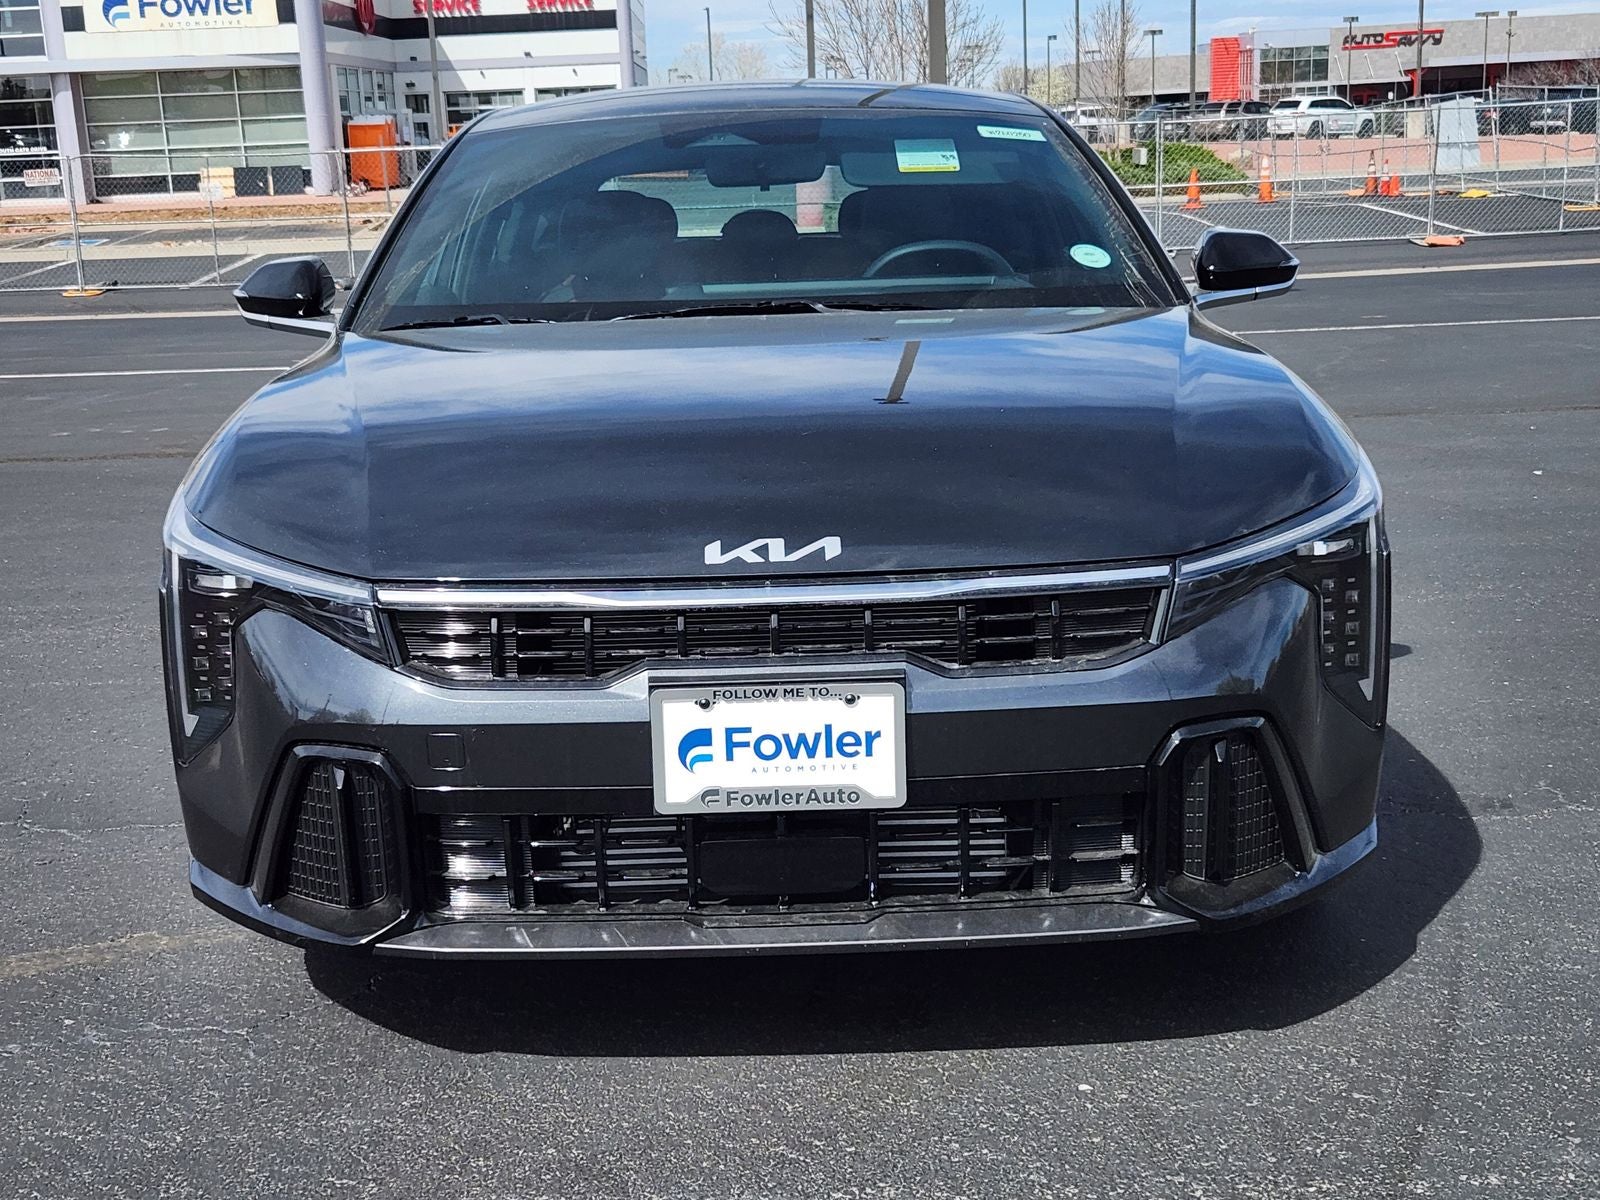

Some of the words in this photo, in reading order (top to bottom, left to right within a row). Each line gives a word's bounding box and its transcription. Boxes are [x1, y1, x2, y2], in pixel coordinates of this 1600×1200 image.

[138, 0, 253, 18] Fowler
[160, 20, 242, 28] AUTOMOTIVE
[25, 169, 58, 178] NATIONAL
[704, 536, 842, 565] KIA
[713, 689, 778, 700] FOLLOW
[783, 688, 805, 698] ME
[809, 687, 841, 697] TO...
[725, 724, 881, 761] Fowler
[751, 763, 858, 774] AUTOMOTIVE
[726, 788, 860, 807] FowlerAuto
